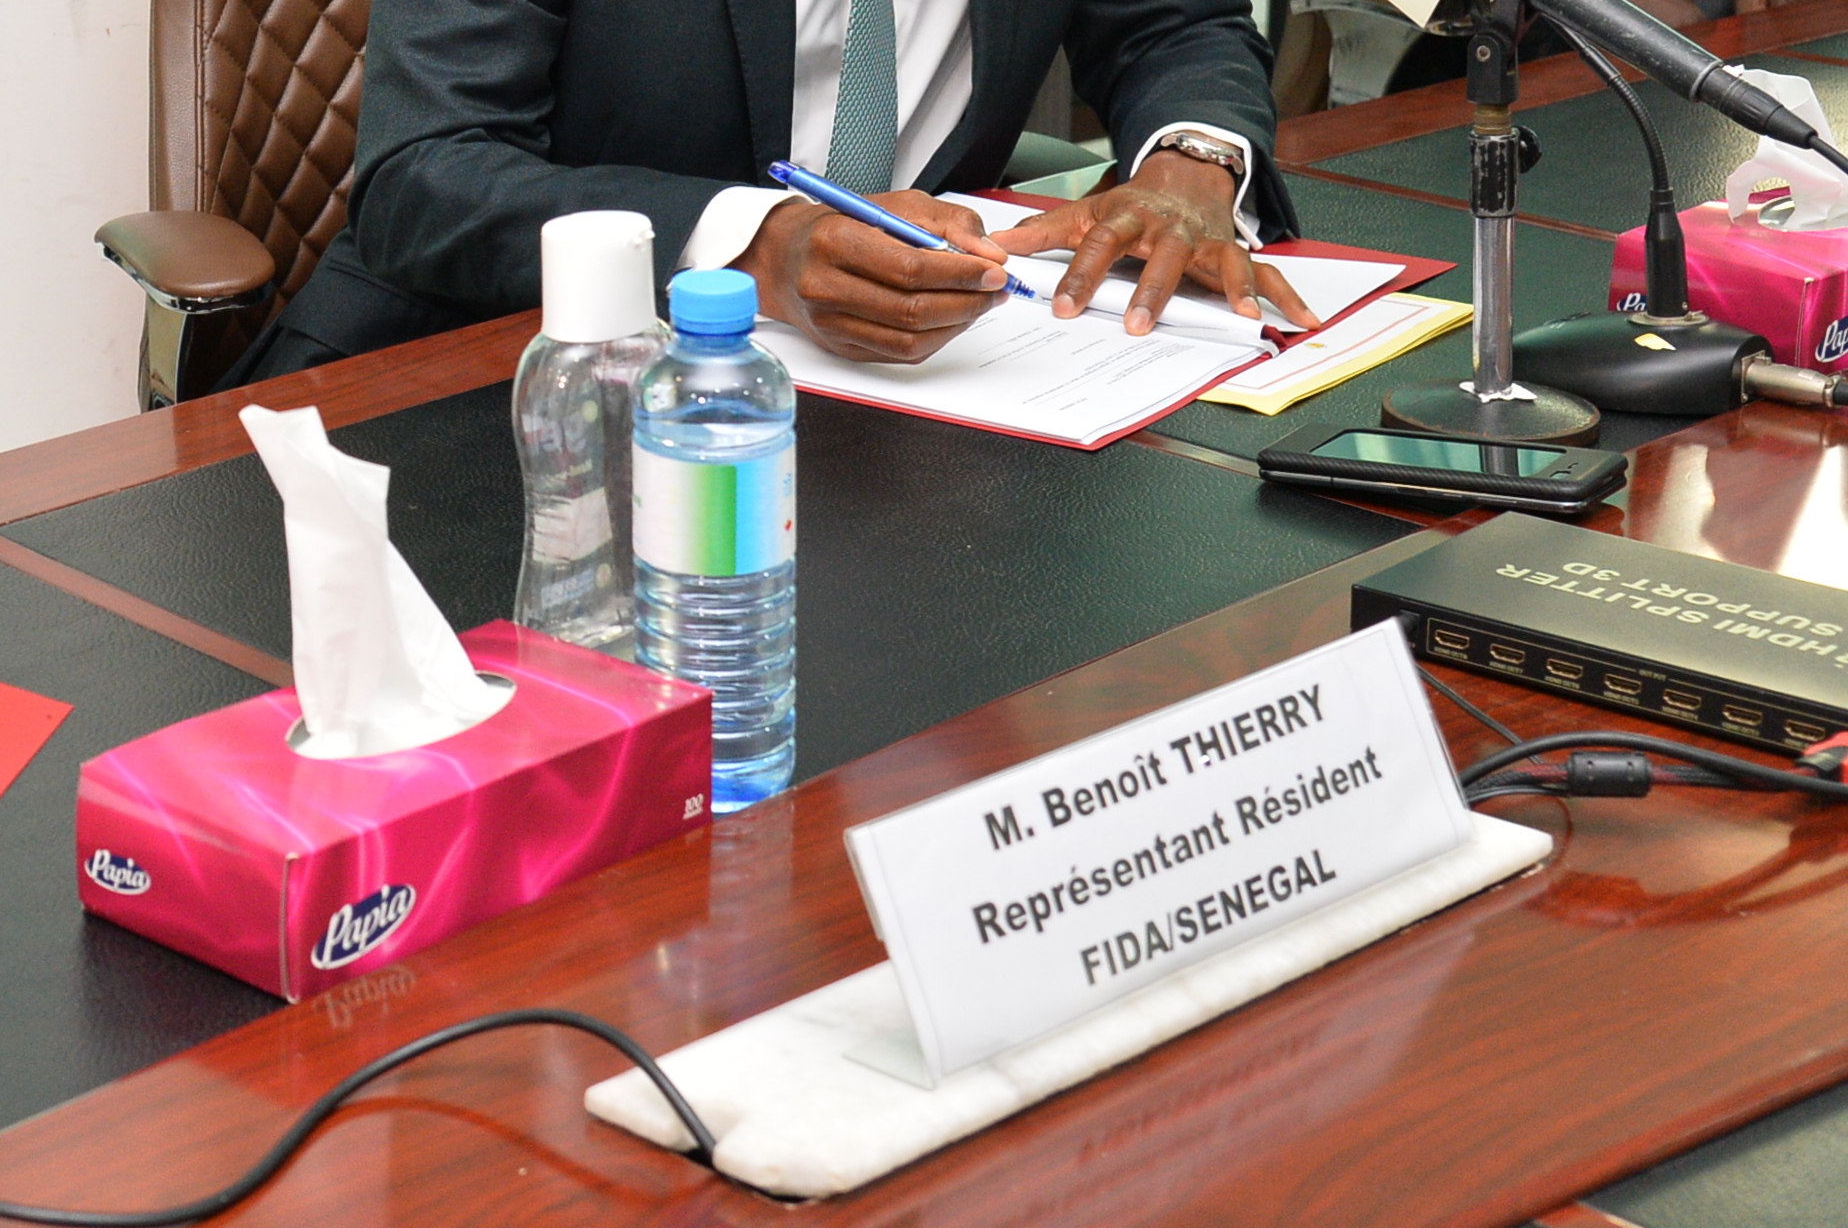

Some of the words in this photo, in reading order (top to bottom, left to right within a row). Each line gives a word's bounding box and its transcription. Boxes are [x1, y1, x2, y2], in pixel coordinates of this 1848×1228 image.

[1495, 563, 1710, 624] SPLITTER
[1562, 562, 1621, 582] 3D
[1621, 578, 1844, 638] SUPPORT
[1713, 619, 1838, 657] HDMI
[984, 805, 1035, 850] M.
[1042, 750, 1167, 827] Benoît
[1170, 684, 1323, 774] THIERRY
[685, 793, 704, 812] 100
[90, 849, 147, 890] Papia
[972, 810, 1230, 944] Représentant
[1235, 745, 1382, 835] Résident
[321, 884, 409, 968] Papia
[1081, 849, 1336, 985] FIDA/SENEGAL
